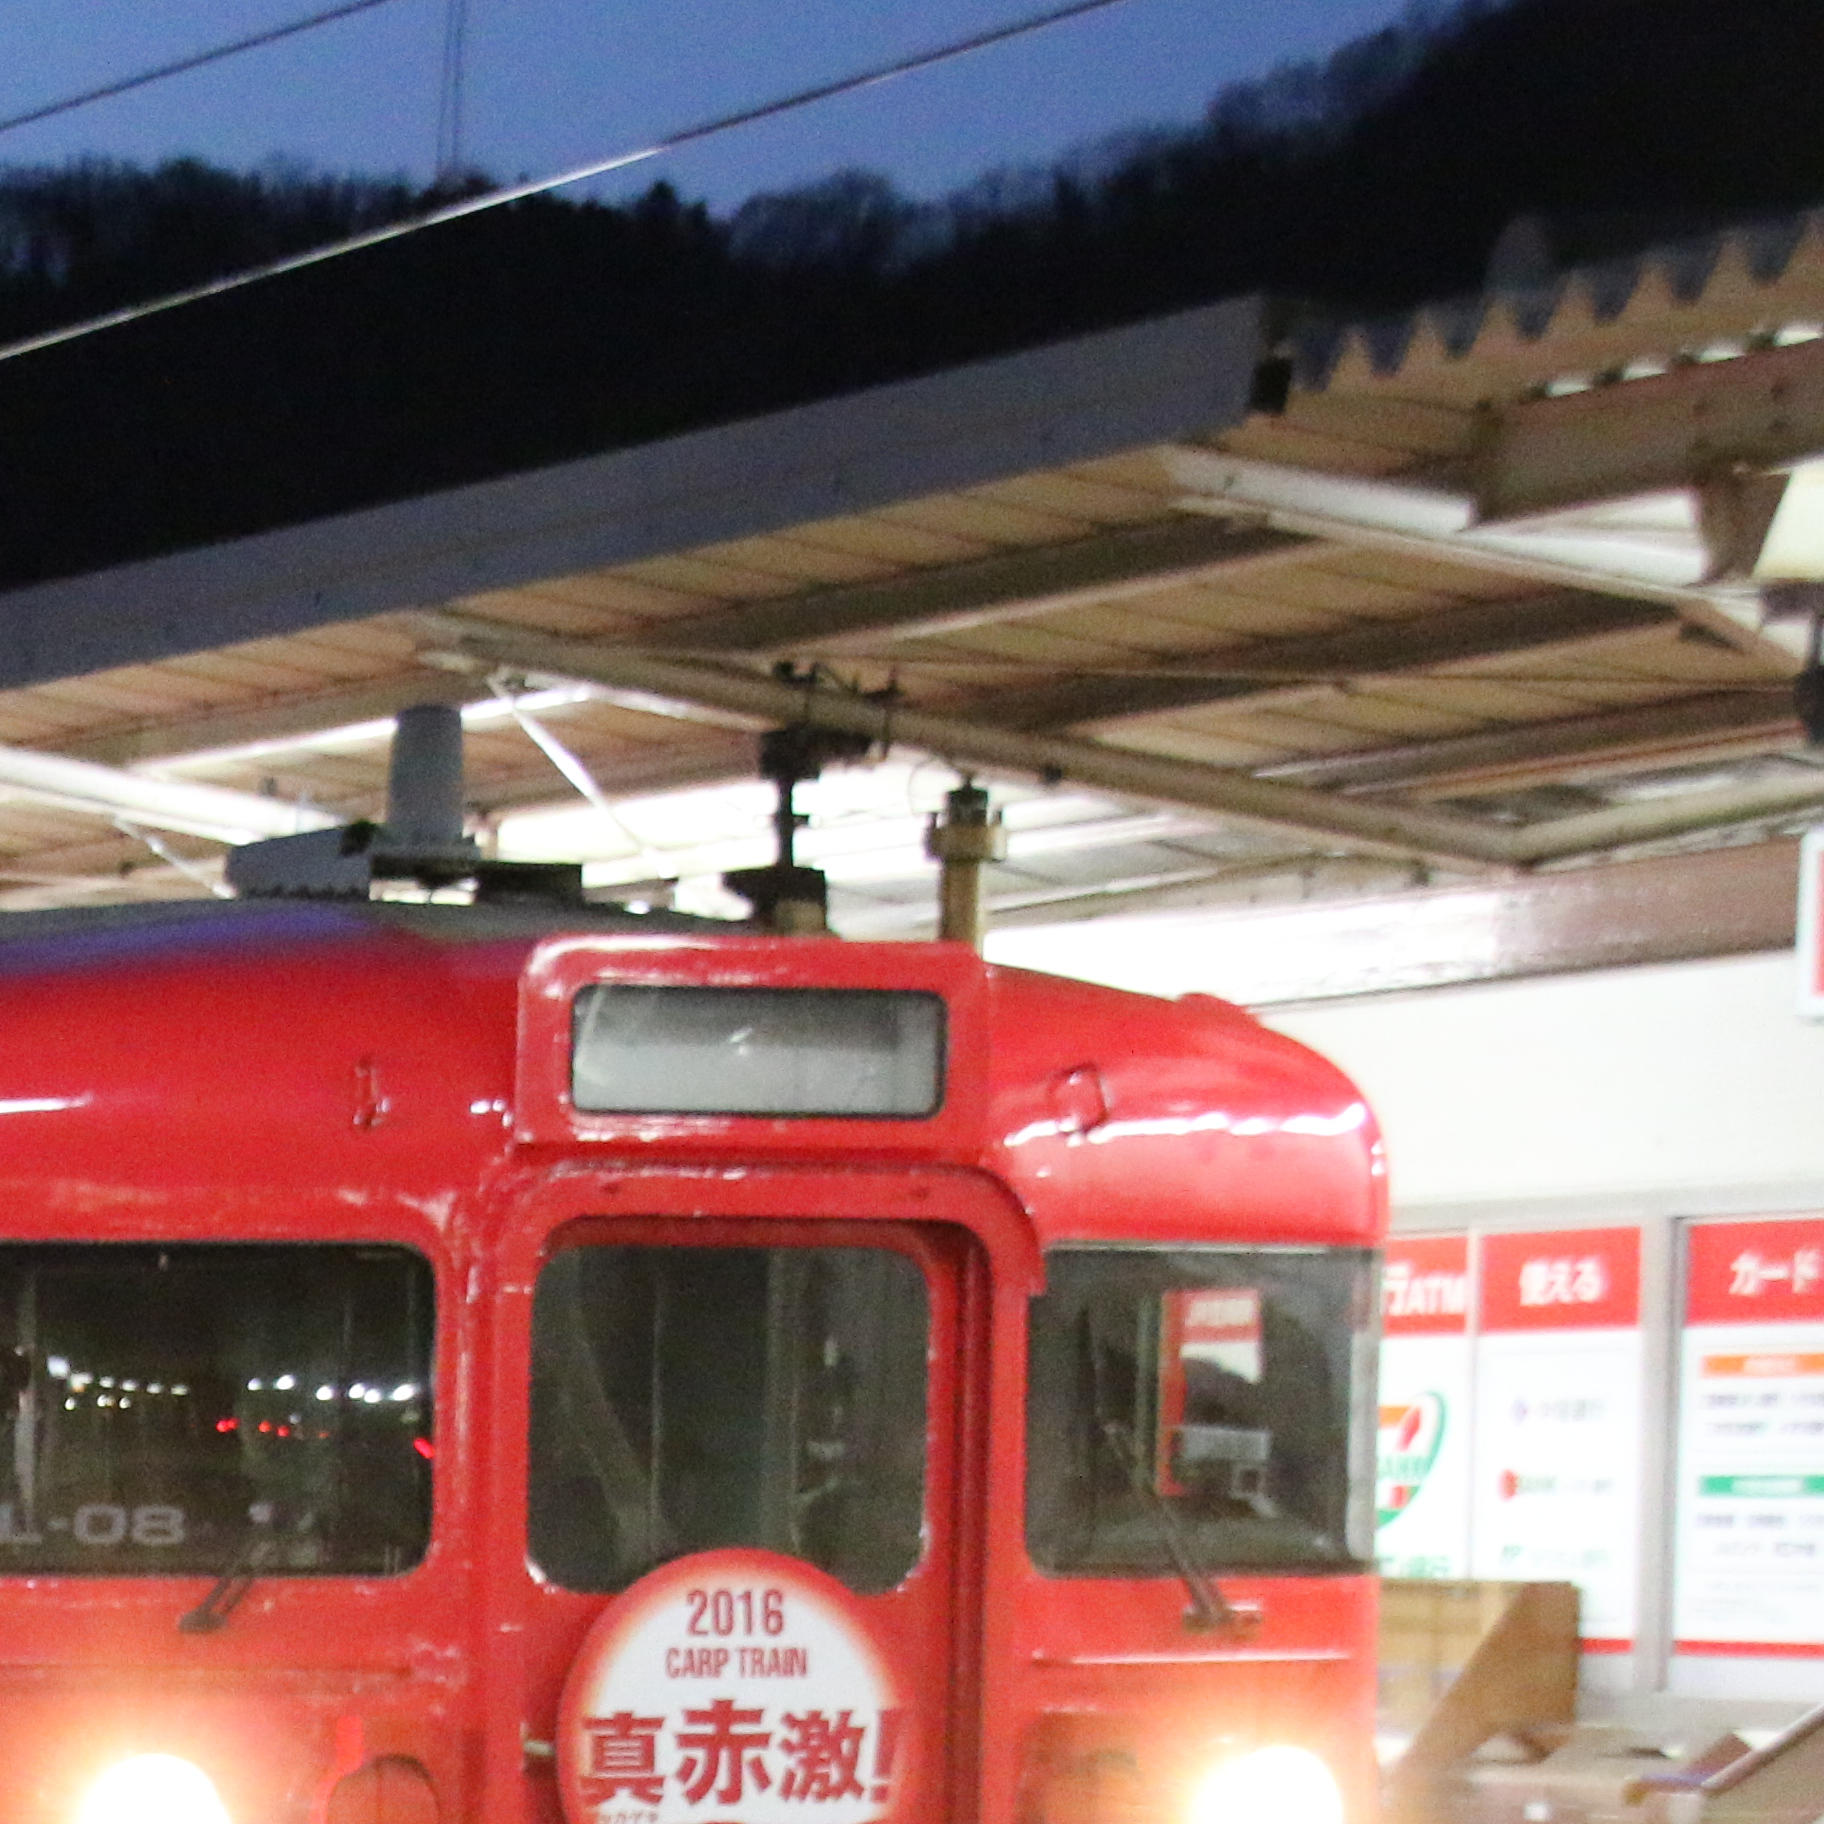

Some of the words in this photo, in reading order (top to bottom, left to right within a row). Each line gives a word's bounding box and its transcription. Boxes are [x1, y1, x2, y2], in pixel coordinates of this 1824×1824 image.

[1519, 1254, 1608, 1308] 使える
[686, 1588, 785, 1638] 2016
[665, 1647, 729, 1679] CARP
[738, 1647, 808, 1679] TRAIN
[578, 1699, 899, 1804] 真赤激!
